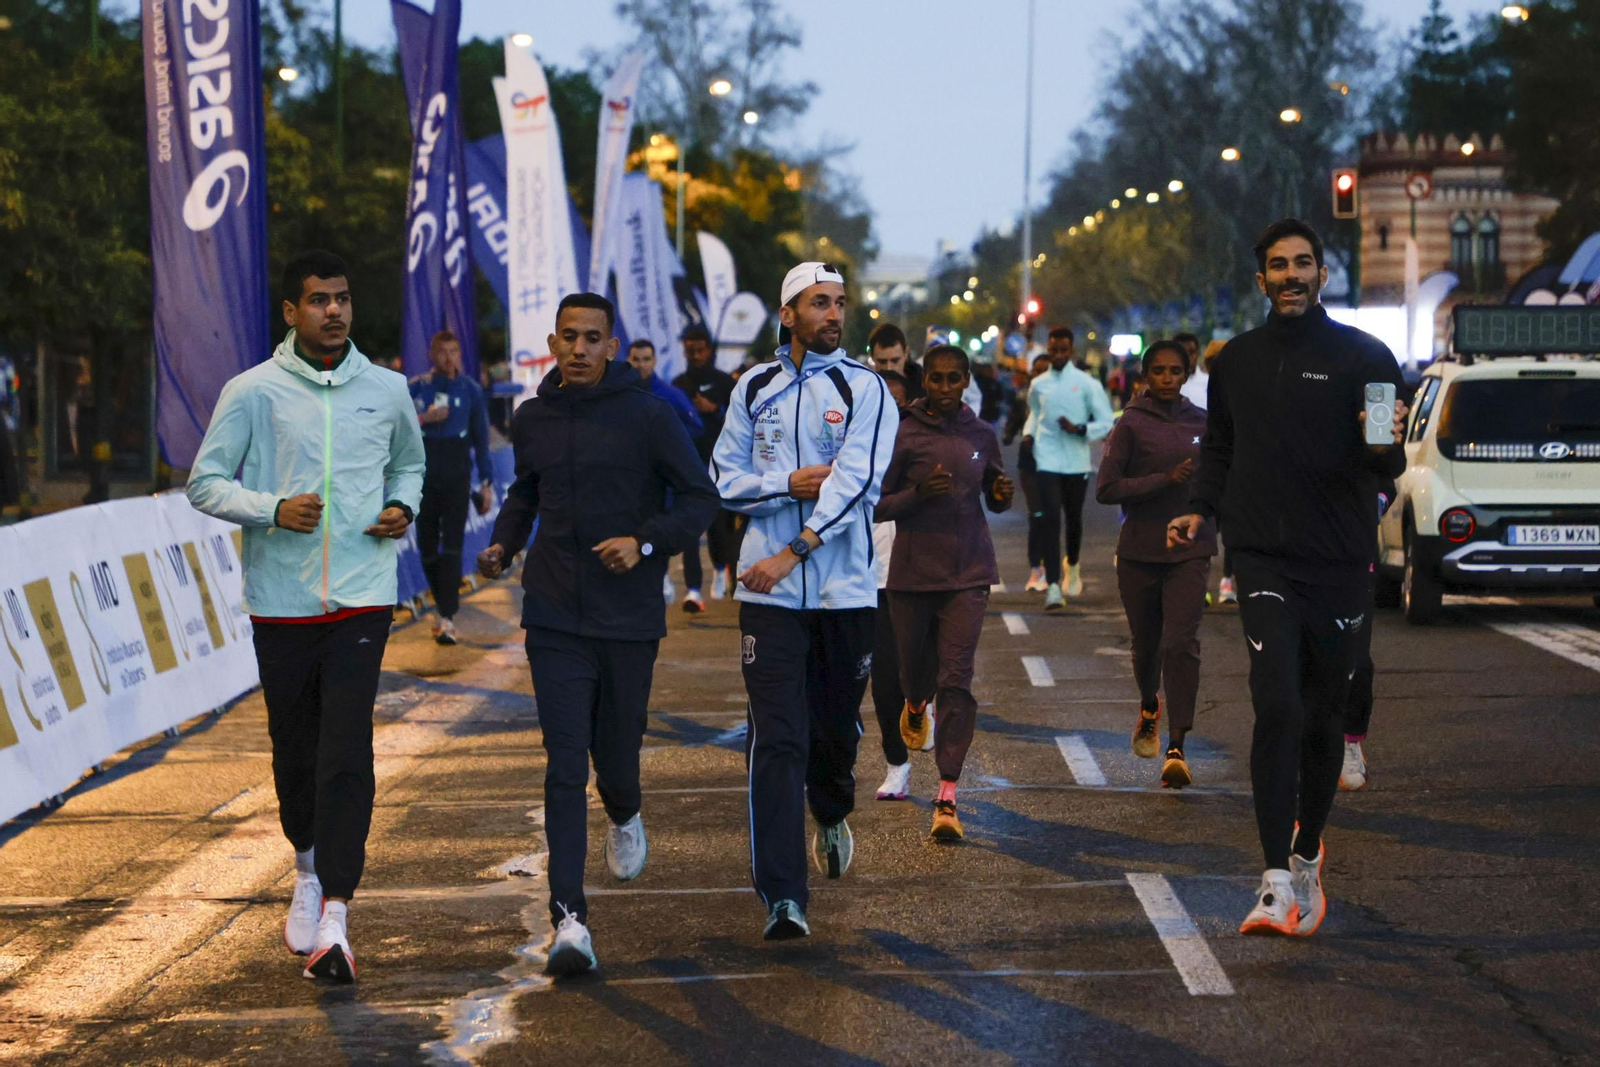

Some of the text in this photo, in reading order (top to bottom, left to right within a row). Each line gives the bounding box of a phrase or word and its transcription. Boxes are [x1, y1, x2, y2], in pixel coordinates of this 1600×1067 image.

[1302, 371, 1329, 381] OYSHO
[1521, 527, 1596, 542] 1369 MXN
